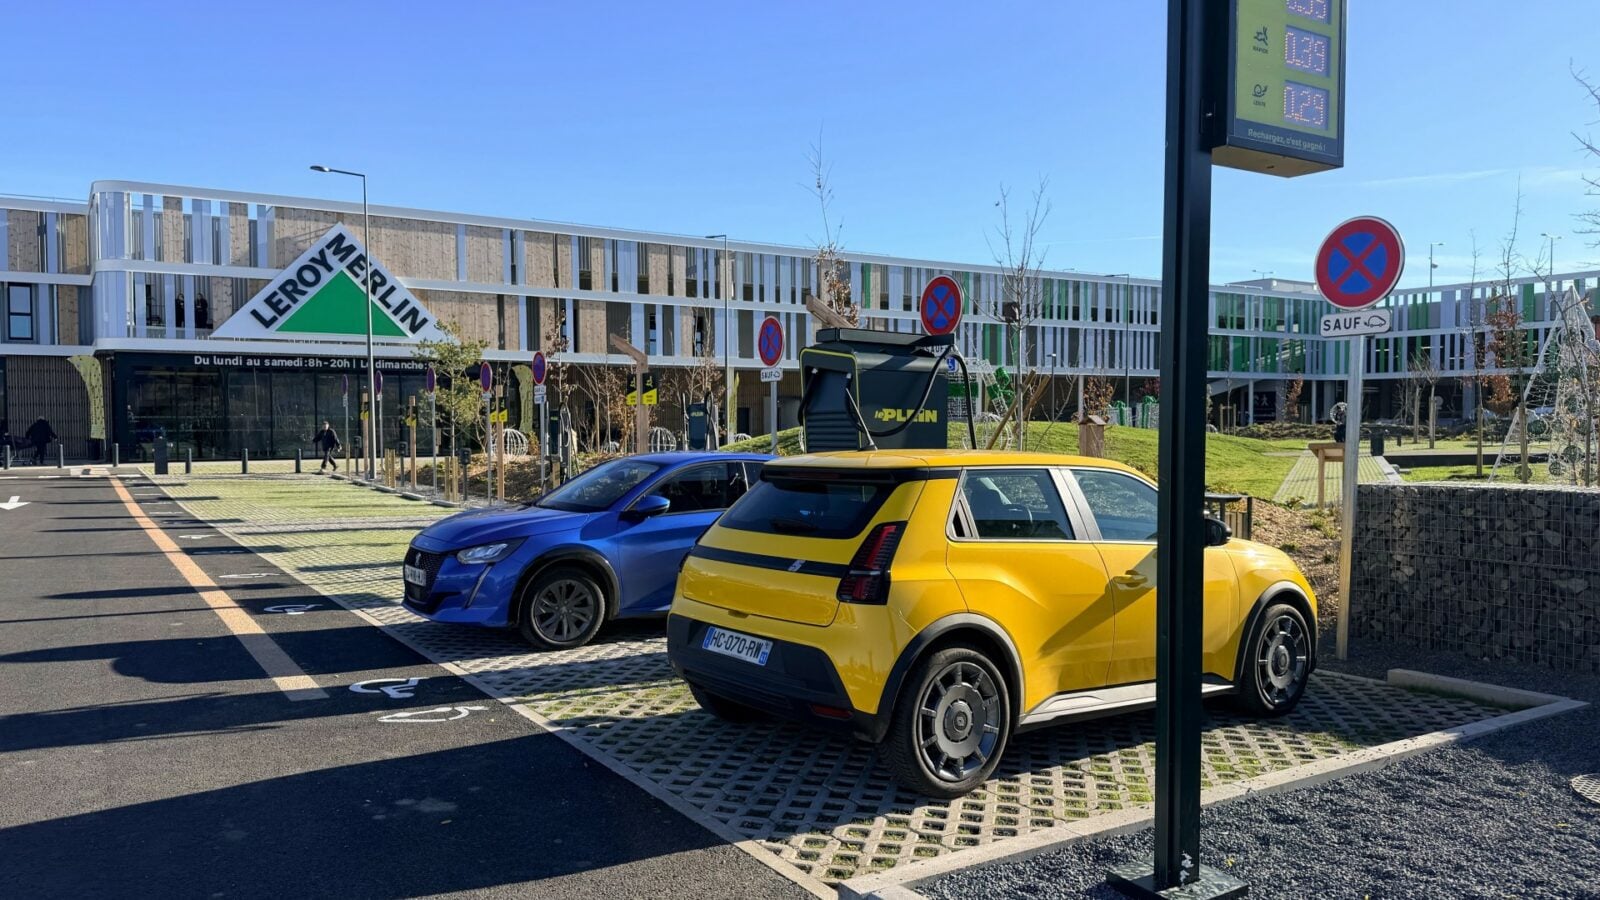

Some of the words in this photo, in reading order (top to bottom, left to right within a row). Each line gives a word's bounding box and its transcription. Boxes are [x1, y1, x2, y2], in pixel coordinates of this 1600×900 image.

[250, 248, 334, 329] LEROY
[325, 232, 429, 334] MERLIN
[1323, 316, 1361, 331] SAUF
[194, 355, 210, 365] Du
[213, 355, 243, 366] lundi
[246, 358, 261, 366] au
